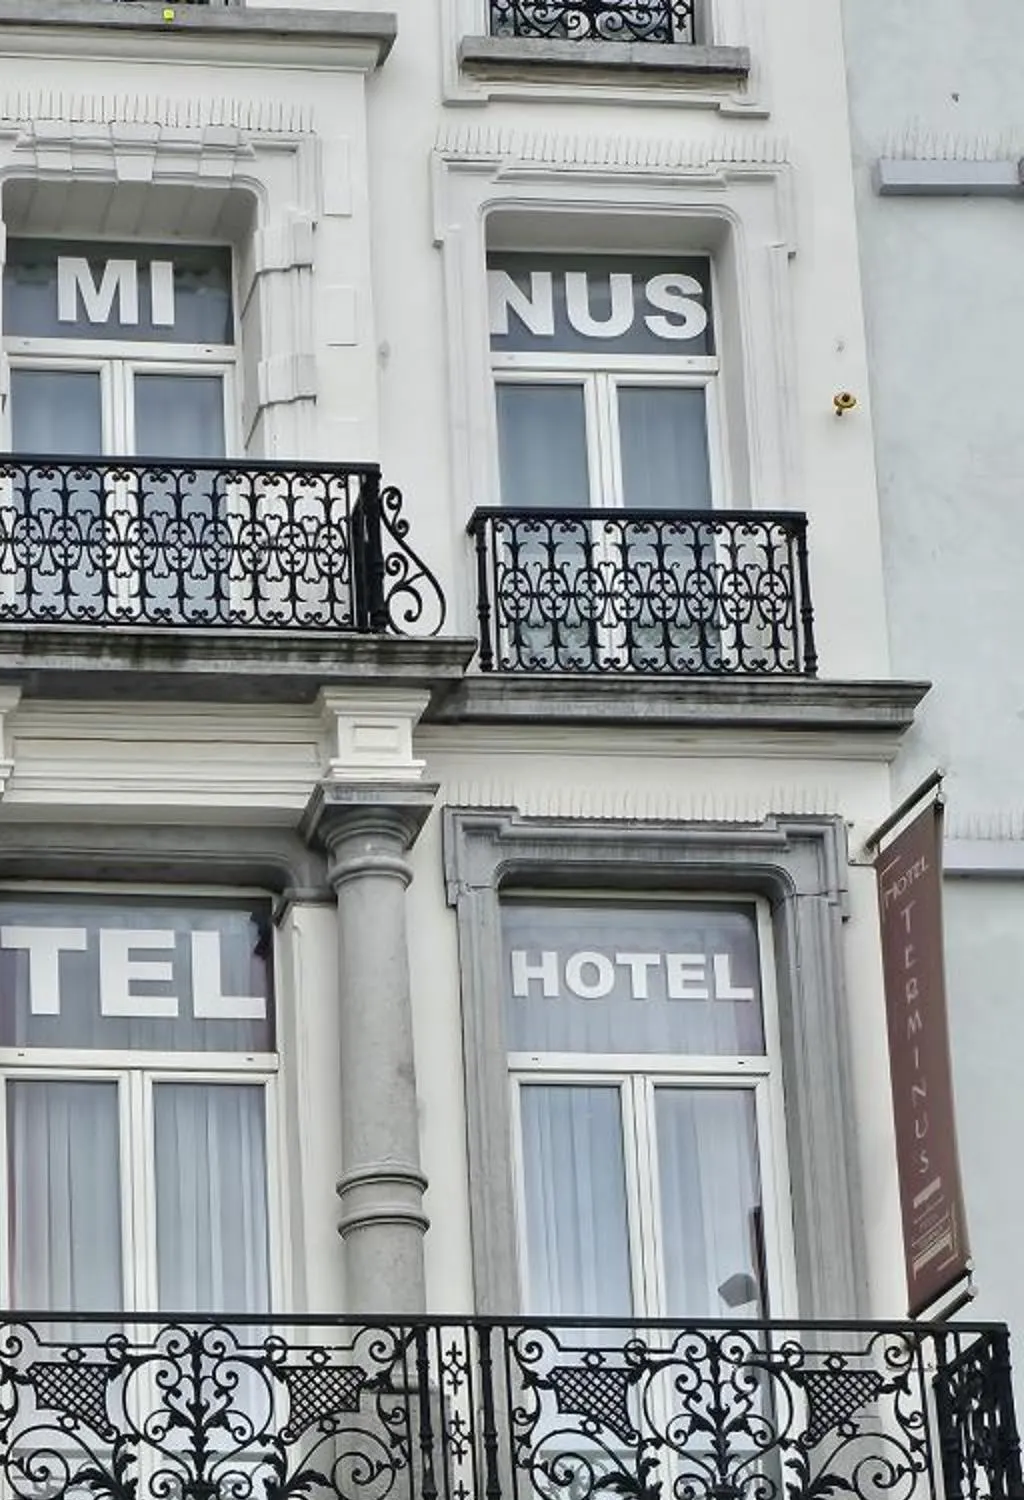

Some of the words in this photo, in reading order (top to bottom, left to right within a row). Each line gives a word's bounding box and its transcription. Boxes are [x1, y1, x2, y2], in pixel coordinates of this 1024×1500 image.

[57, 256, 176, 326] MI
[488, 269, 709, 341] NUS
[884, 856, 930, 909] HOTEL
[0, 925, 268, 1021] TEL
[510, 949, 755, 1002] HOTEL
